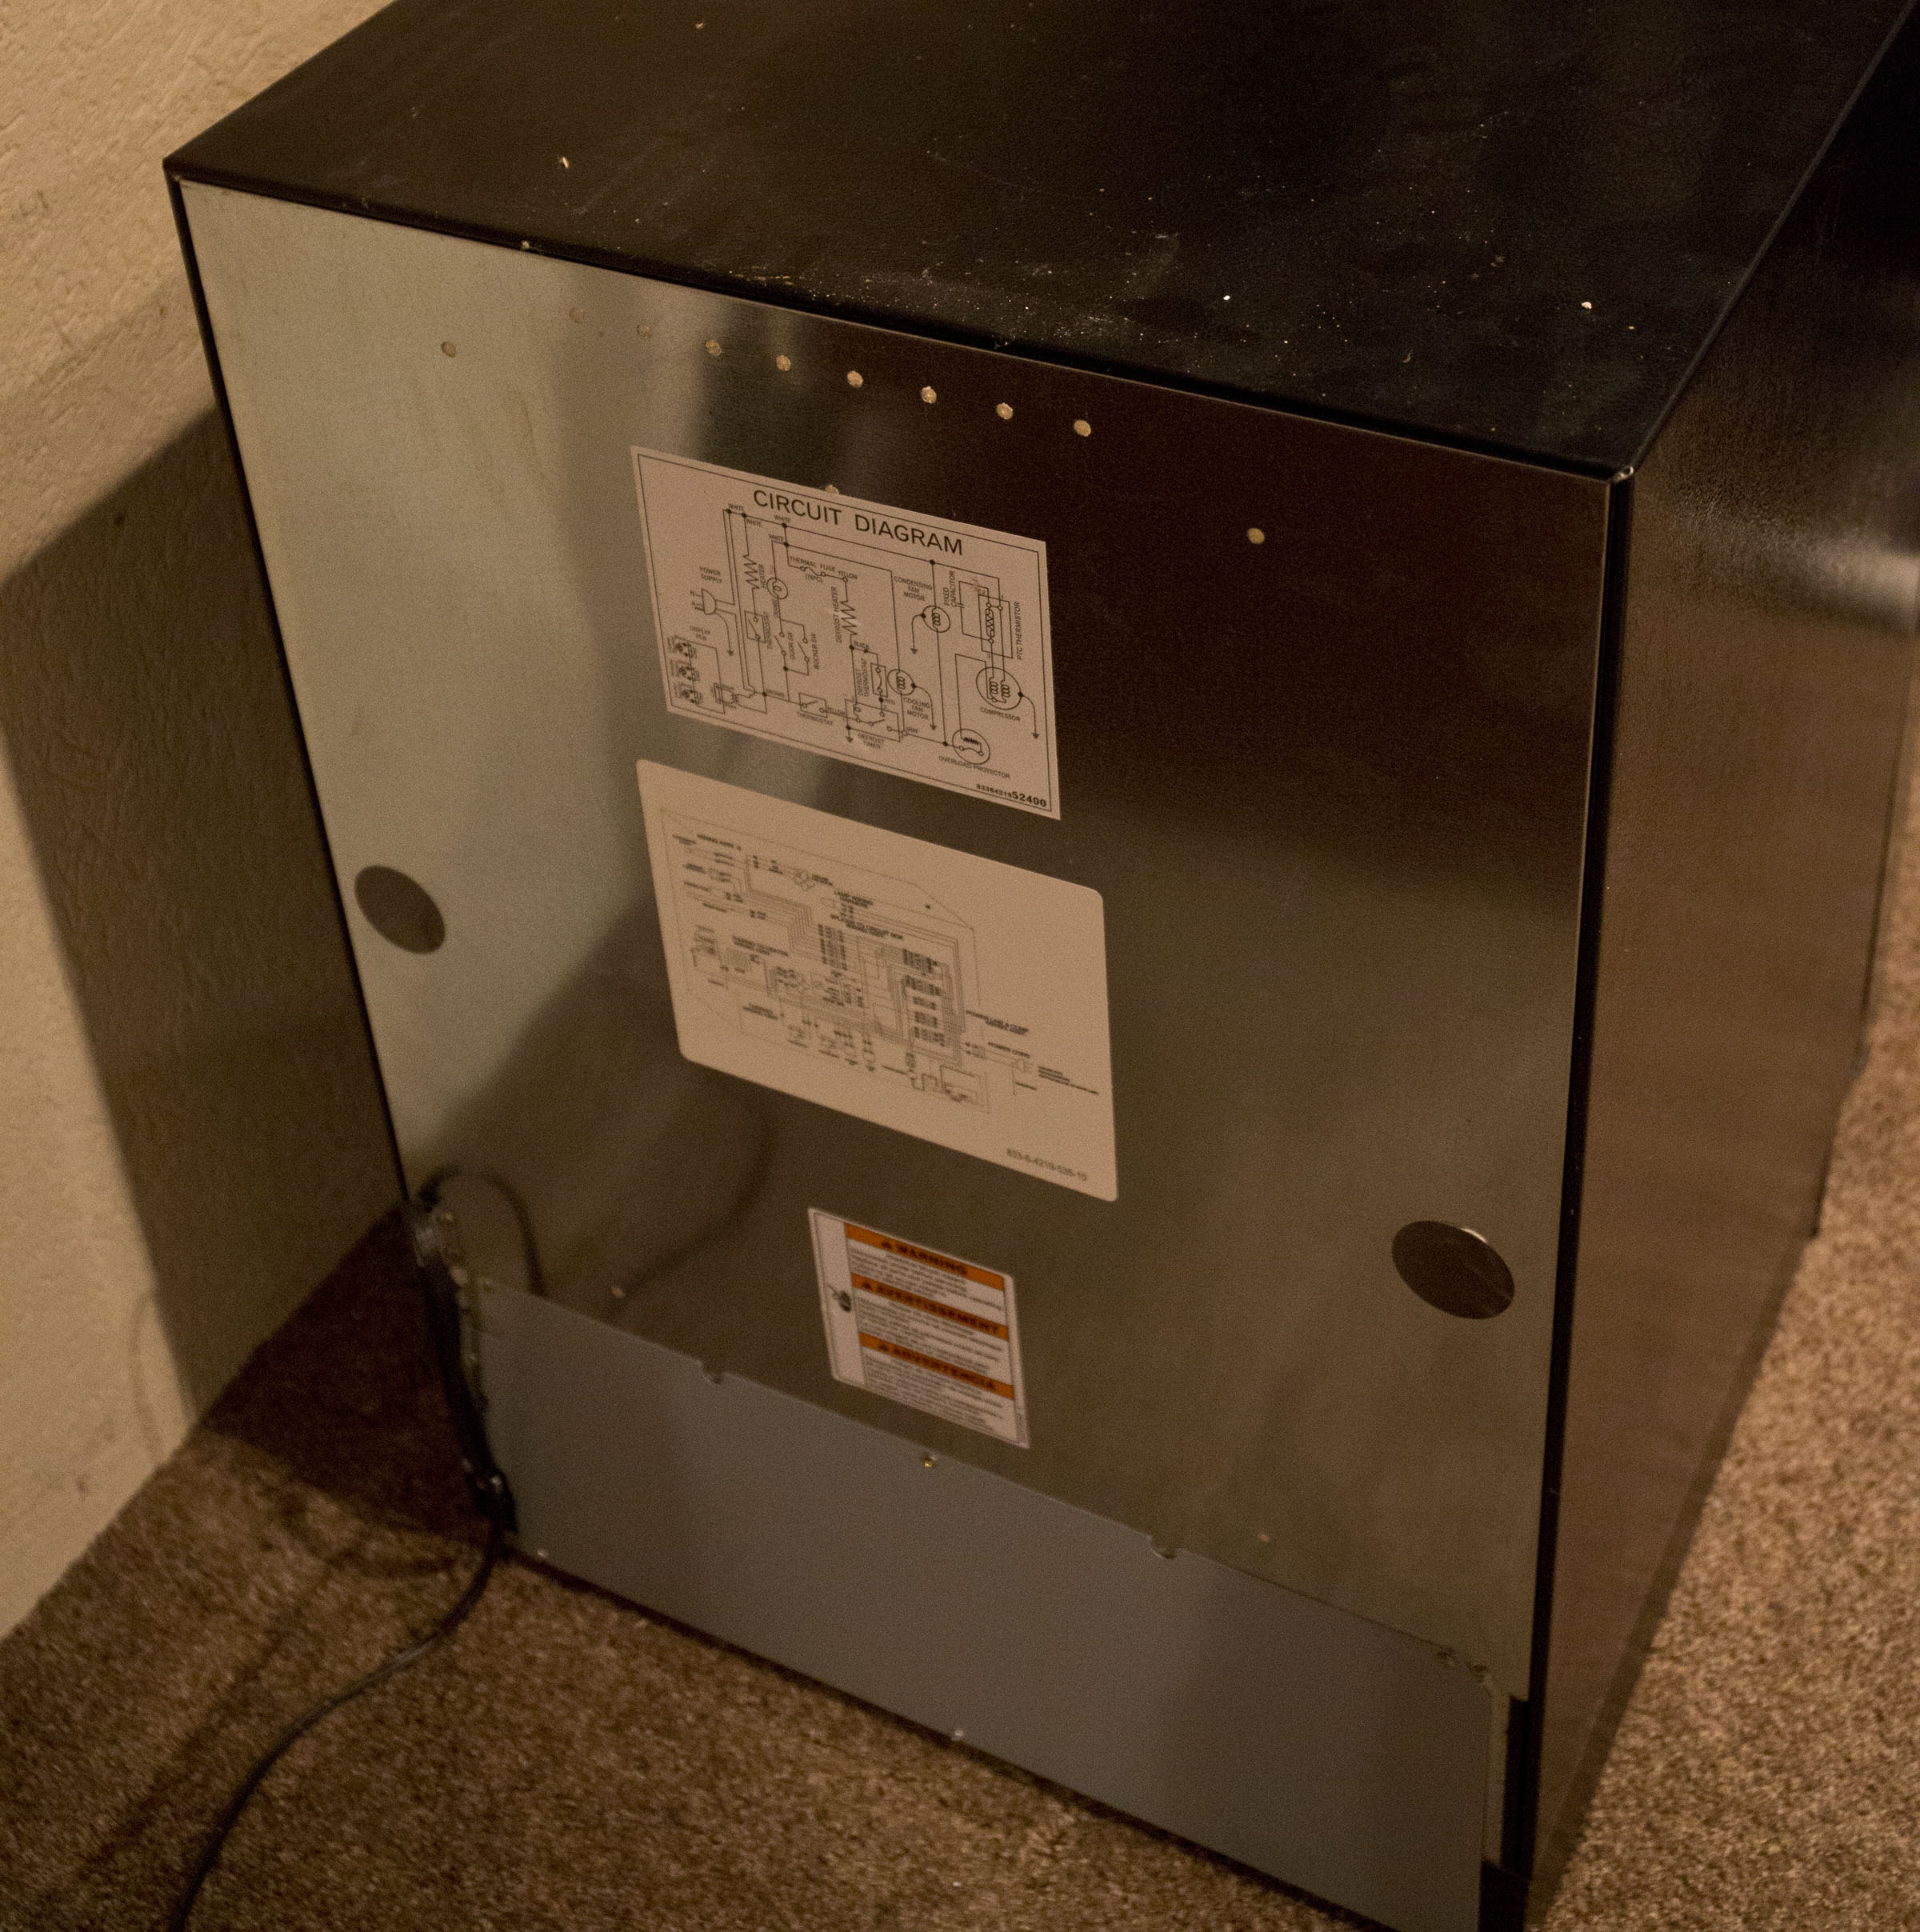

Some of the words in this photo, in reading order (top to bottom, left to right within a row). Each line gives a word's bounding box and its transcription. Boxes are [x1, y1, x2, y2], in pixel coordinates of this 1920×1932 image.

[728, 502, 745, 511] WHITE
[747, 519, 762, 527] WHITE
[753, 490, 842, 525] CIRCUIT
[854, 514, 962, 555] DIAGRAM
[774, 514, 790, 522] WHITE
[768, 534, 785, 542] WHITE
[699, 566, 722, 576] POWER
[790, 555, 818, 568] THERMAL
[820, 564, 836, 573] FUSE
[700, 574, 722, 583] SUPPLY
[758, 563, 766, 589] HEATER
[838, 570, 858, 580] YELLOW
[894, 576, 933, 590] CONDENSING
[907, 586, 920, 594] FAN
[949, 570, 957, 608] CAPACITOR
[830, 586, 839, 613] HEATER
[903, 591, 925, 602] MOTOR
[763, 610, 773, 650] THERMOSTAT
[833, 614, 842, 643] DEFROST
[1014, 602, 1022, 644] THERMISTOR
[787, 630, 793, 641] SW
[811, 633, 817, 642] SW
[861, 658, 870, 697] THERMOSTAT
[903, 697, 930, 709] COOLING
[797, 711, 833, 726] THERMOSTAT
[907, 710, 929, 720] MOTOR
[980, 706, 1021, 722] COMPRESSOR
[858, 733, 885, 745] DEFROST
[938, 755, 972, 769] OVERLOAD
[973, 764, 1010, 779] PROTECTOR
[895, 1242, 968, 1275] WARNING
[877, 1284, 1000, 1334] AVERTISSEMENT
[892, 1347, 997, 1390] ADVERTENCIA
